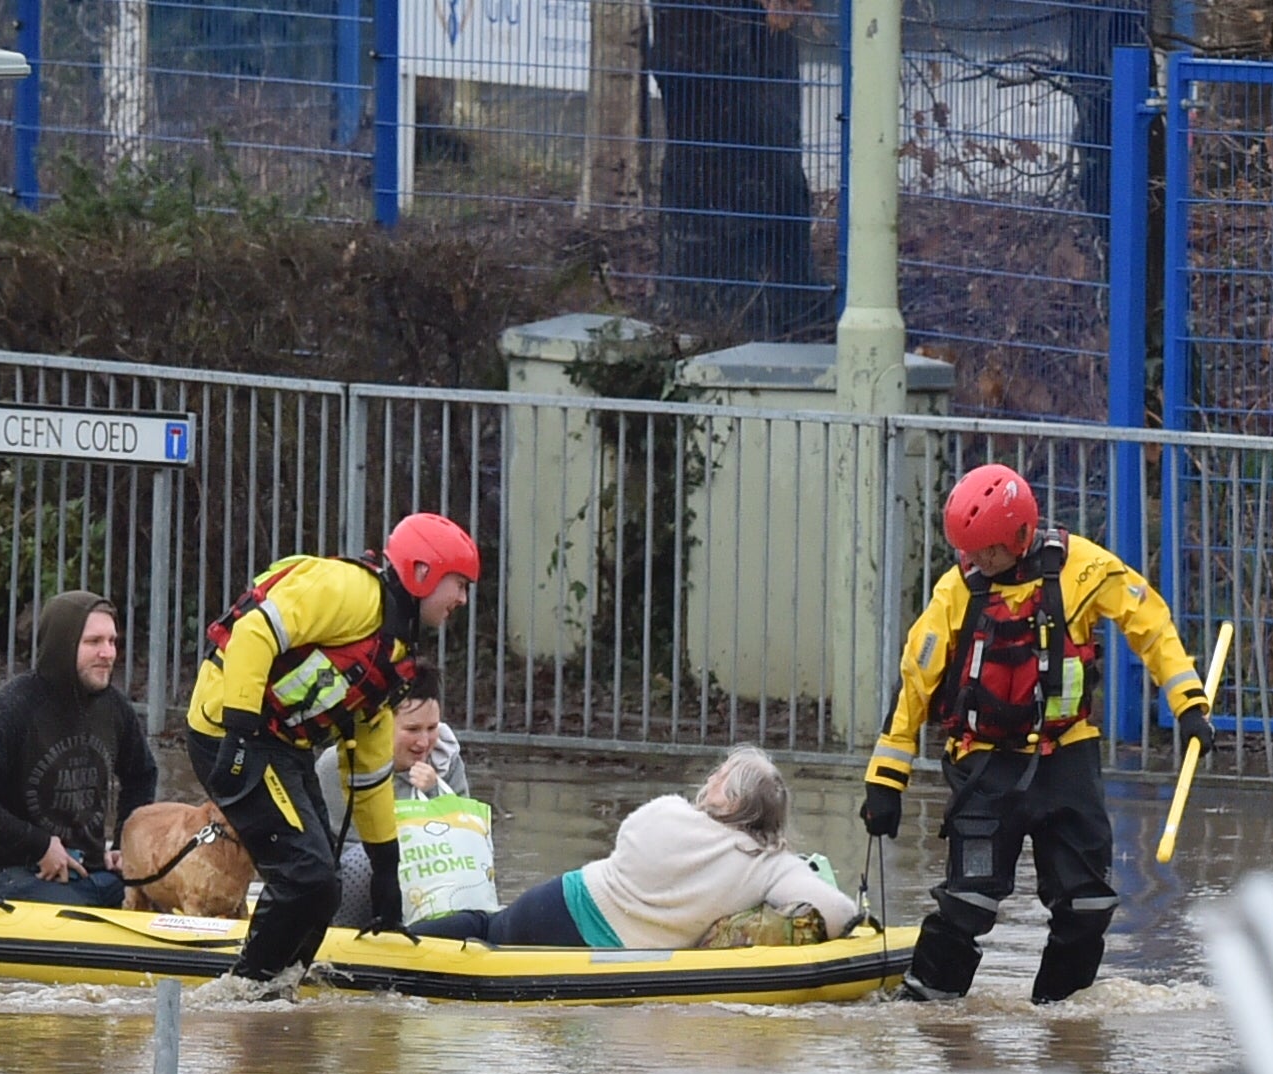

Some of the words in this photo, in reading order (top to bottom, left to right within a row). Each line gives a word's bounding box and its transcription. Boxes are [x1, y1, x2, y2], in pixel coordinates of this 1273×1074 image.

[4, 415, 63, 448] CEFN
[76, 419, 138, 453] COED
[401, 842, 453, 864] RING
[417, 856, 476, 878] HOME
